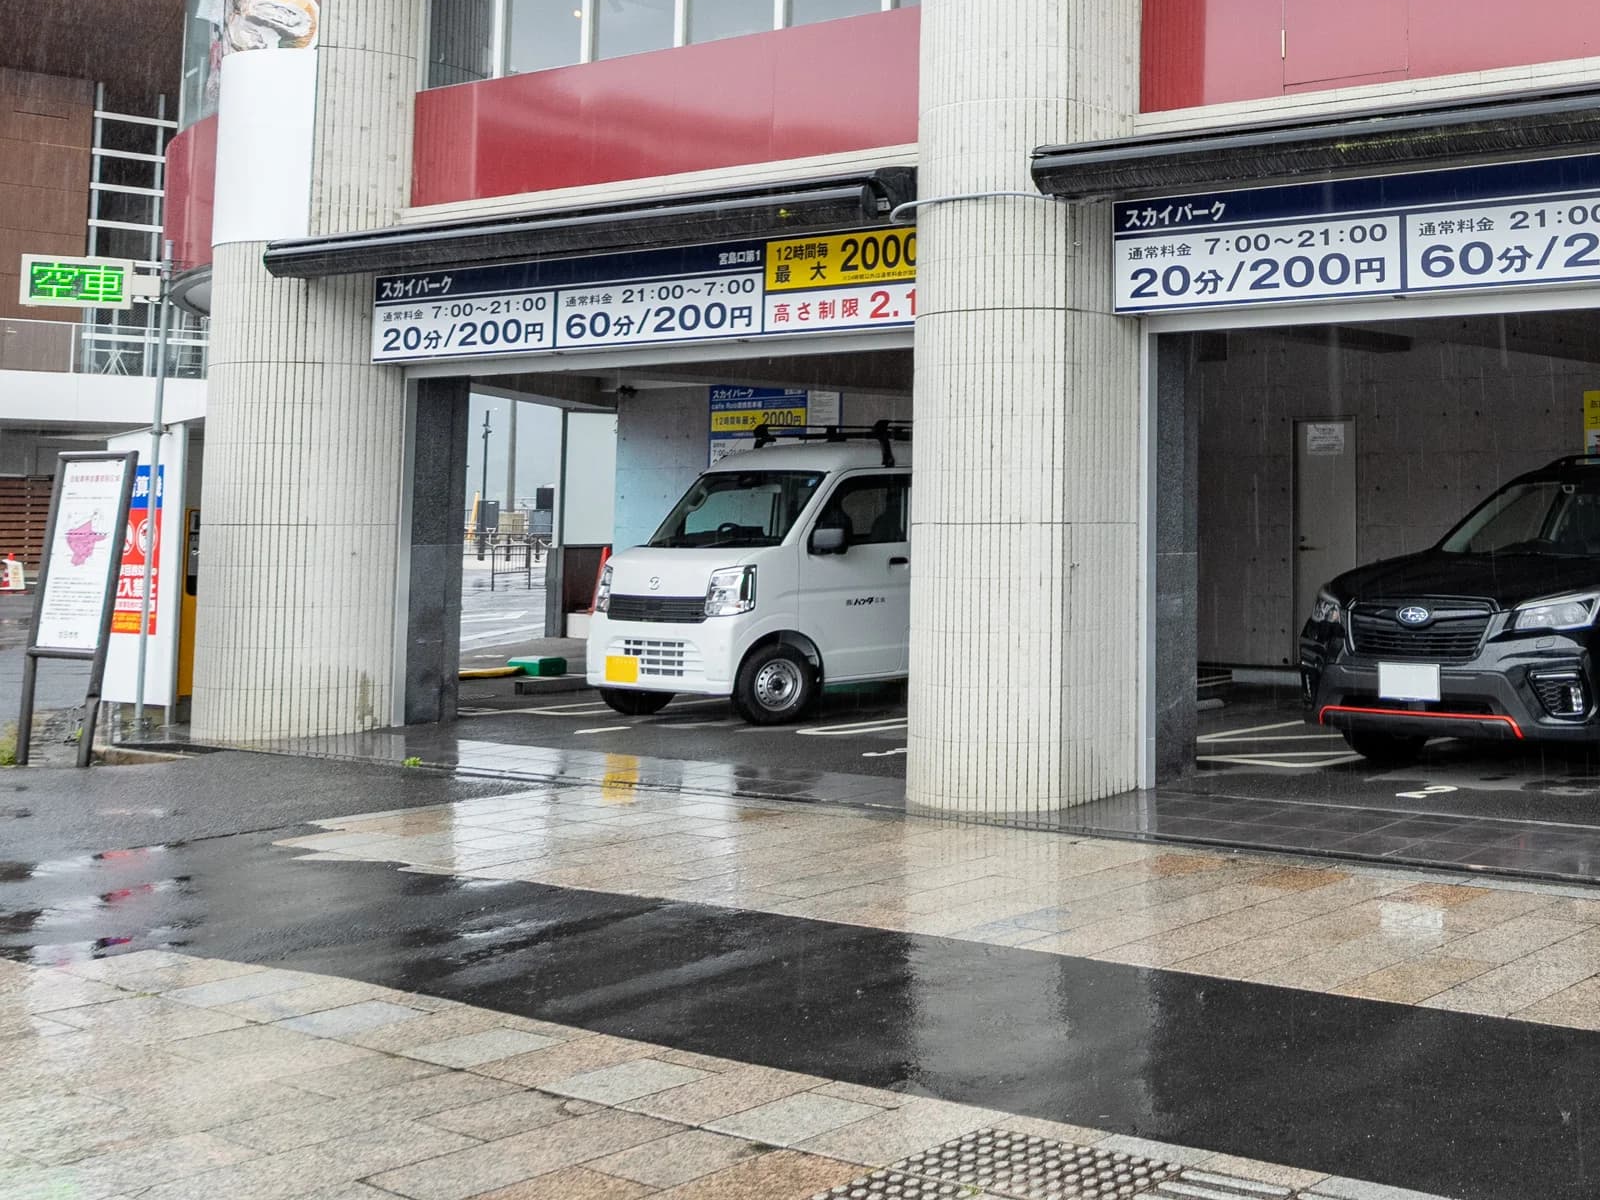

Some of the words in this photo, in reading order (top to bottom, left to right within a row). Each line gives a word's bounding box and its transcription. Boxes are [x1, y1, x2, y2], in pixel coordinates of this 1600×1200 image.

[1126, 200, 1226, 228] スカイパーク
[1418, 215, 1495, 237] 通常料金
[776, 242, 828, 262] 12時間毎
[1128, 242, 1192, 262] 通常料金
[30, 262, 124, 302] 空車
[381, 276, 453, 298] スカイパーク
[1129, 252, 1386, 298] 20分/200円
[565, 292, 613, 308] 通常料金
[774, 298, 859, 324] 高さ制限
[383, 310, 424, 322] 通常料金
[565, 302, 753, 339] 60分/200円
[382, 318, 544, 352] 20分/200円
